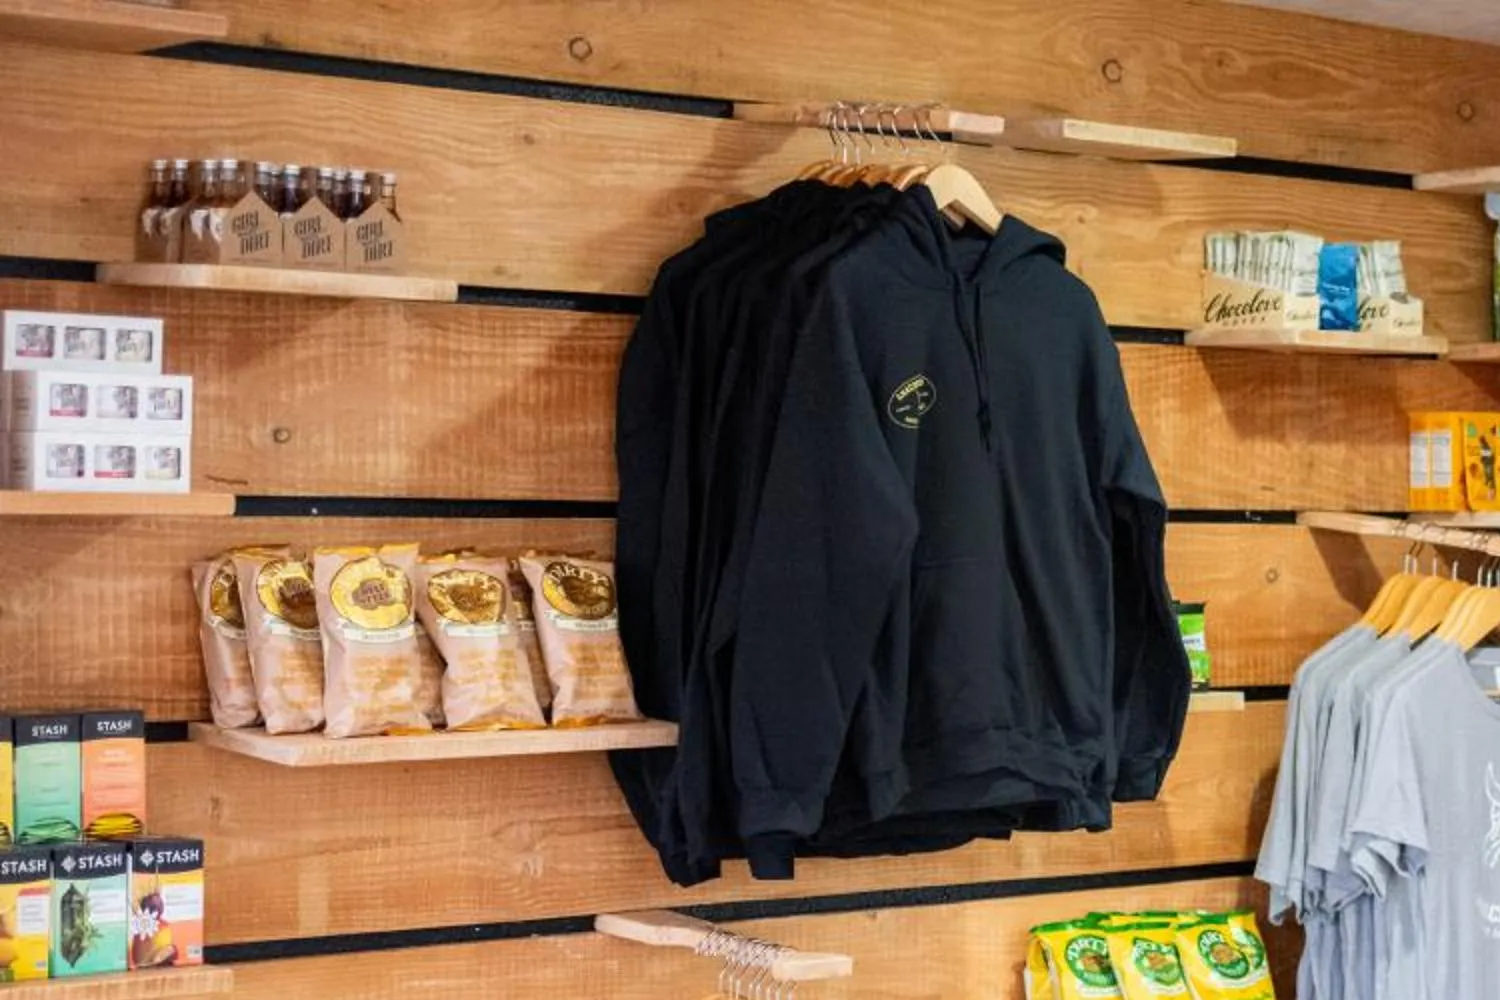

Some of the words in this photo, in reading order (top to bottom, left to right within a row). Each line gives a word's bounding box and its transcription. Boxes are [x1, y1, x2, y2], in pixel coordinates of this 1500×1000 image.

[1203, 288, 1281, 323] Chocolove
[32, 725, 68, 737] STASH
[97, 720, 133, 732] STASH
[78, 853, 123, 870] STASH
[156, 849, 200, 865] STASH
[1, 859, 47, 875] STASH
